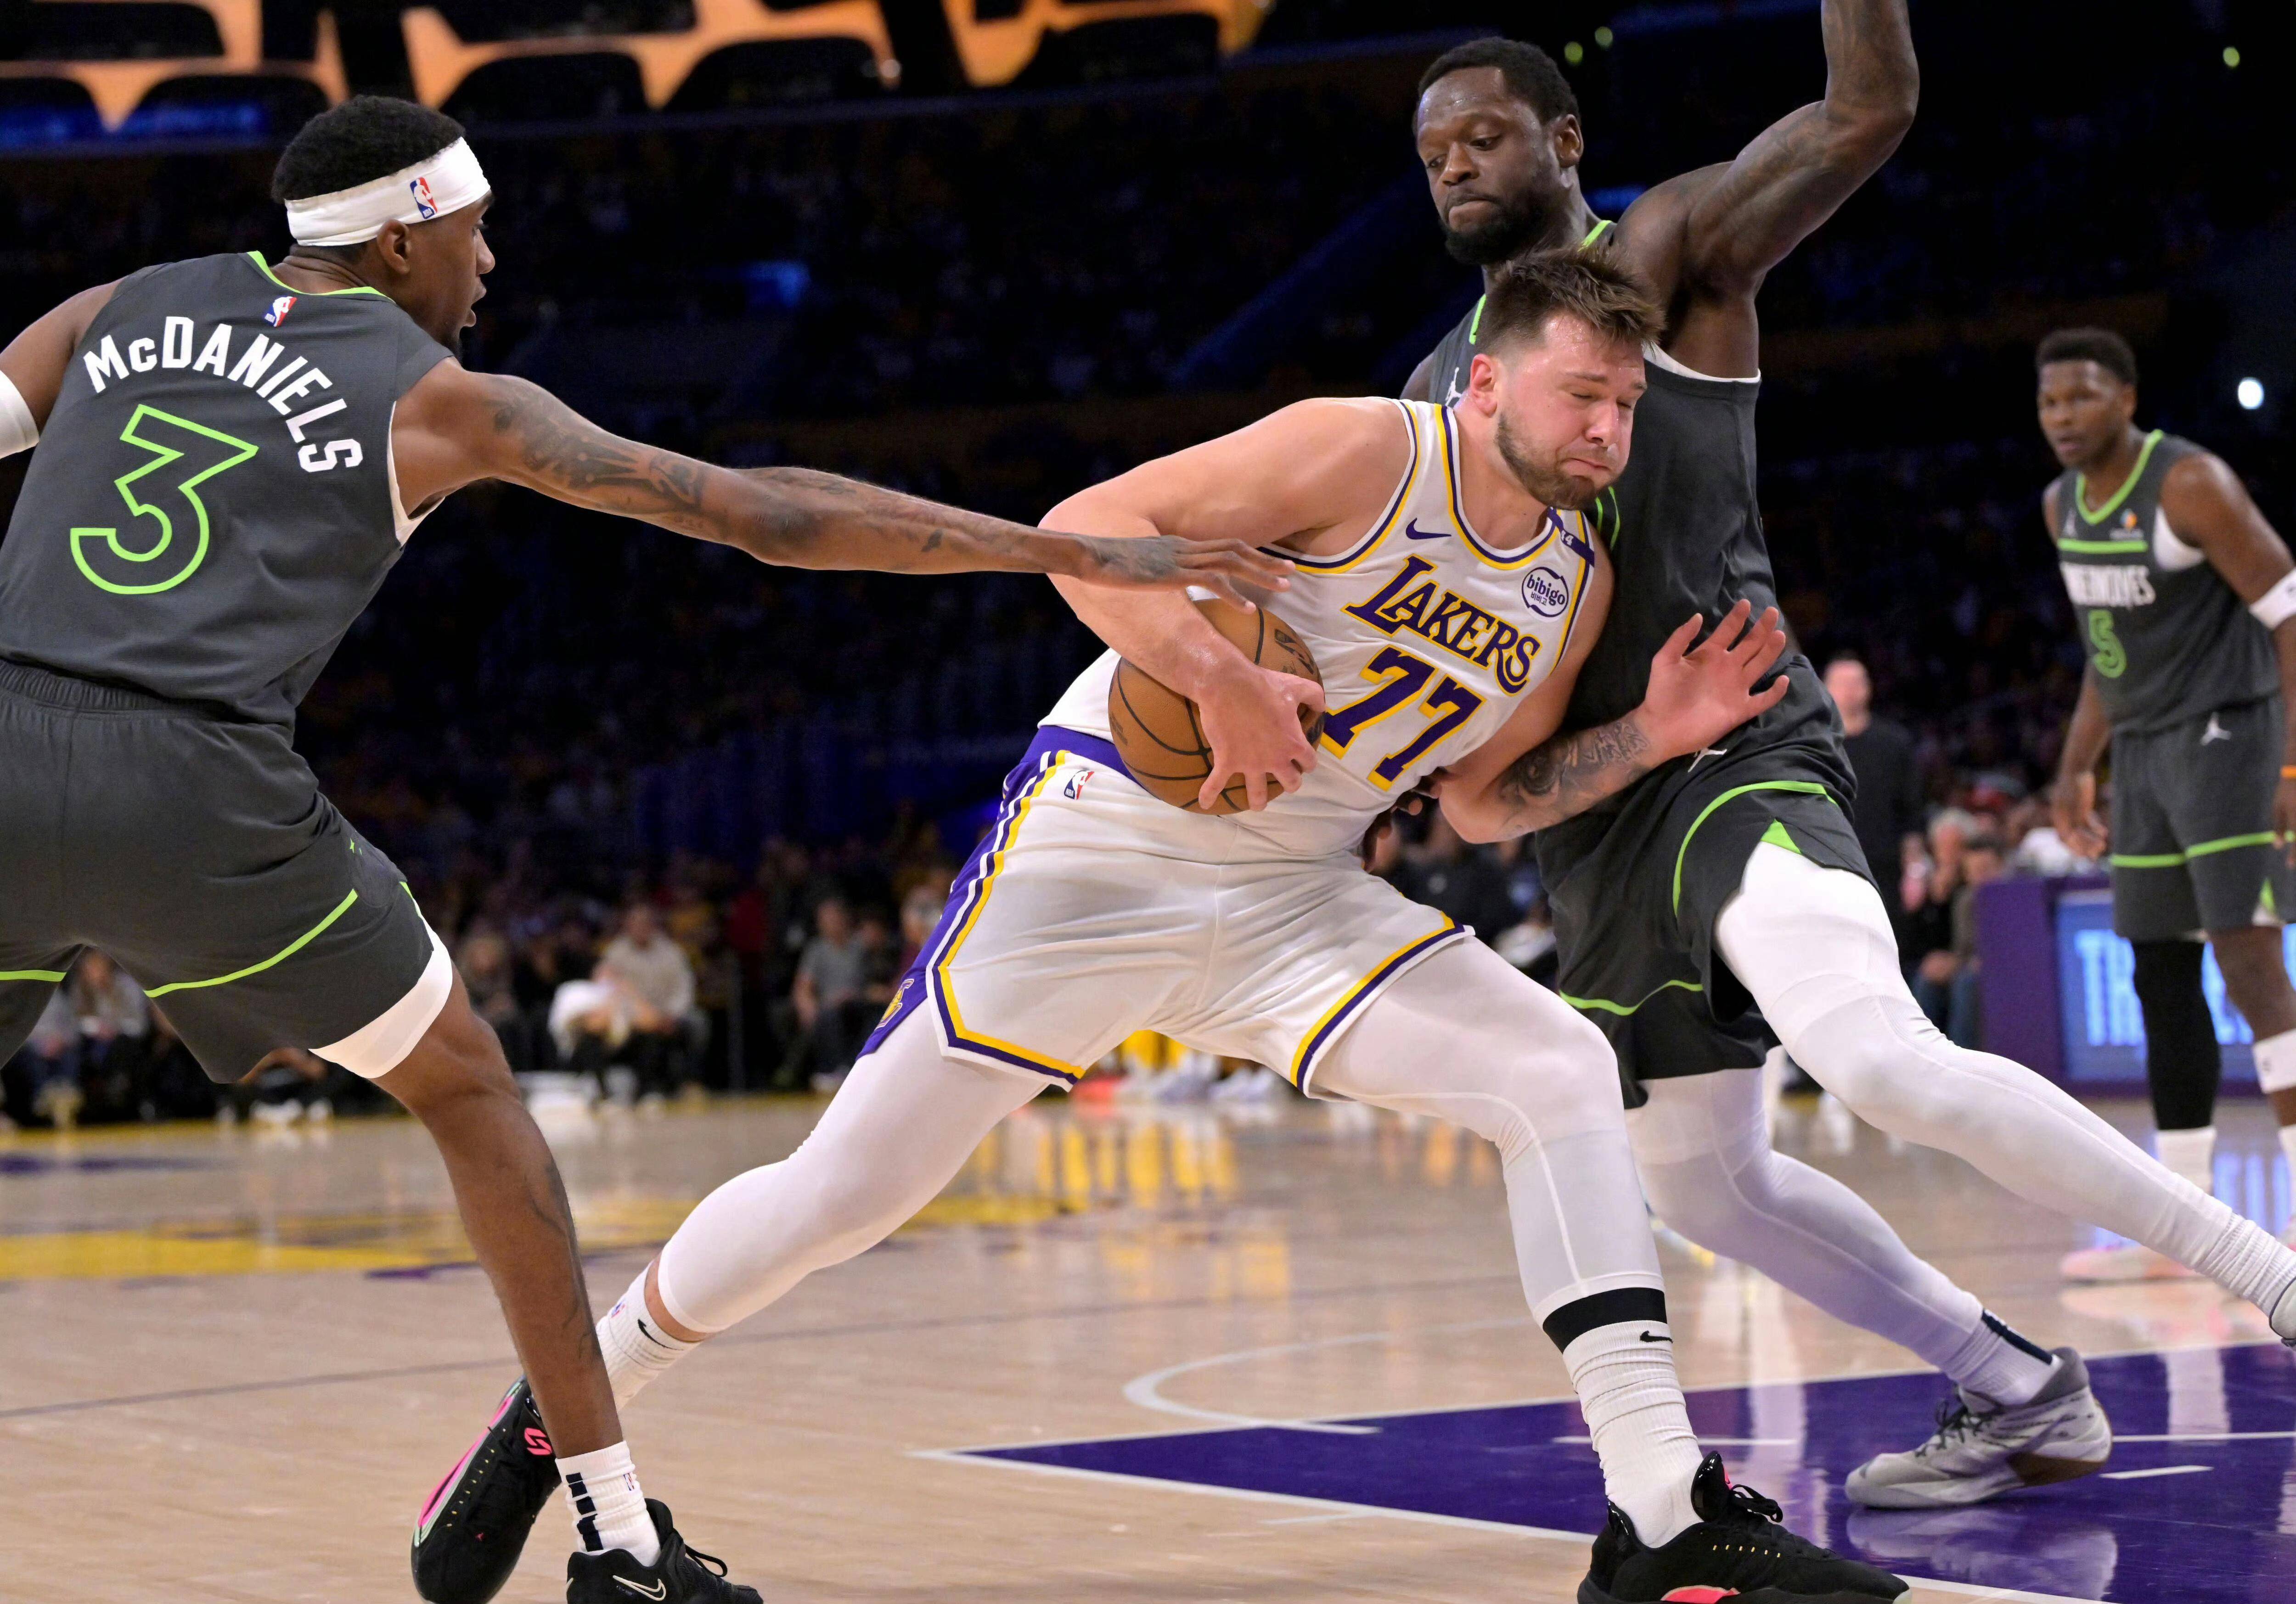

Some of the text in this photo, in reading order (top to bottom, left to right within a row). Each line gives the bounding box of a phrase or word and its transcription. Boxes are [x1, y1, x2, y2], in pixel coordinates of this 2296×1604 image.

[83, 316, 363, 472] McDANIELS
[70, 404, 259, 594] 3
[1340, 553, 1542, 697] LAKERS
[1527, 574, 1565, 606] bibigo
[2088, 609, 2127, 679] 5
[1320, 644, 1487, 791] 77
[1065, 788, 1074, 797] NBA
